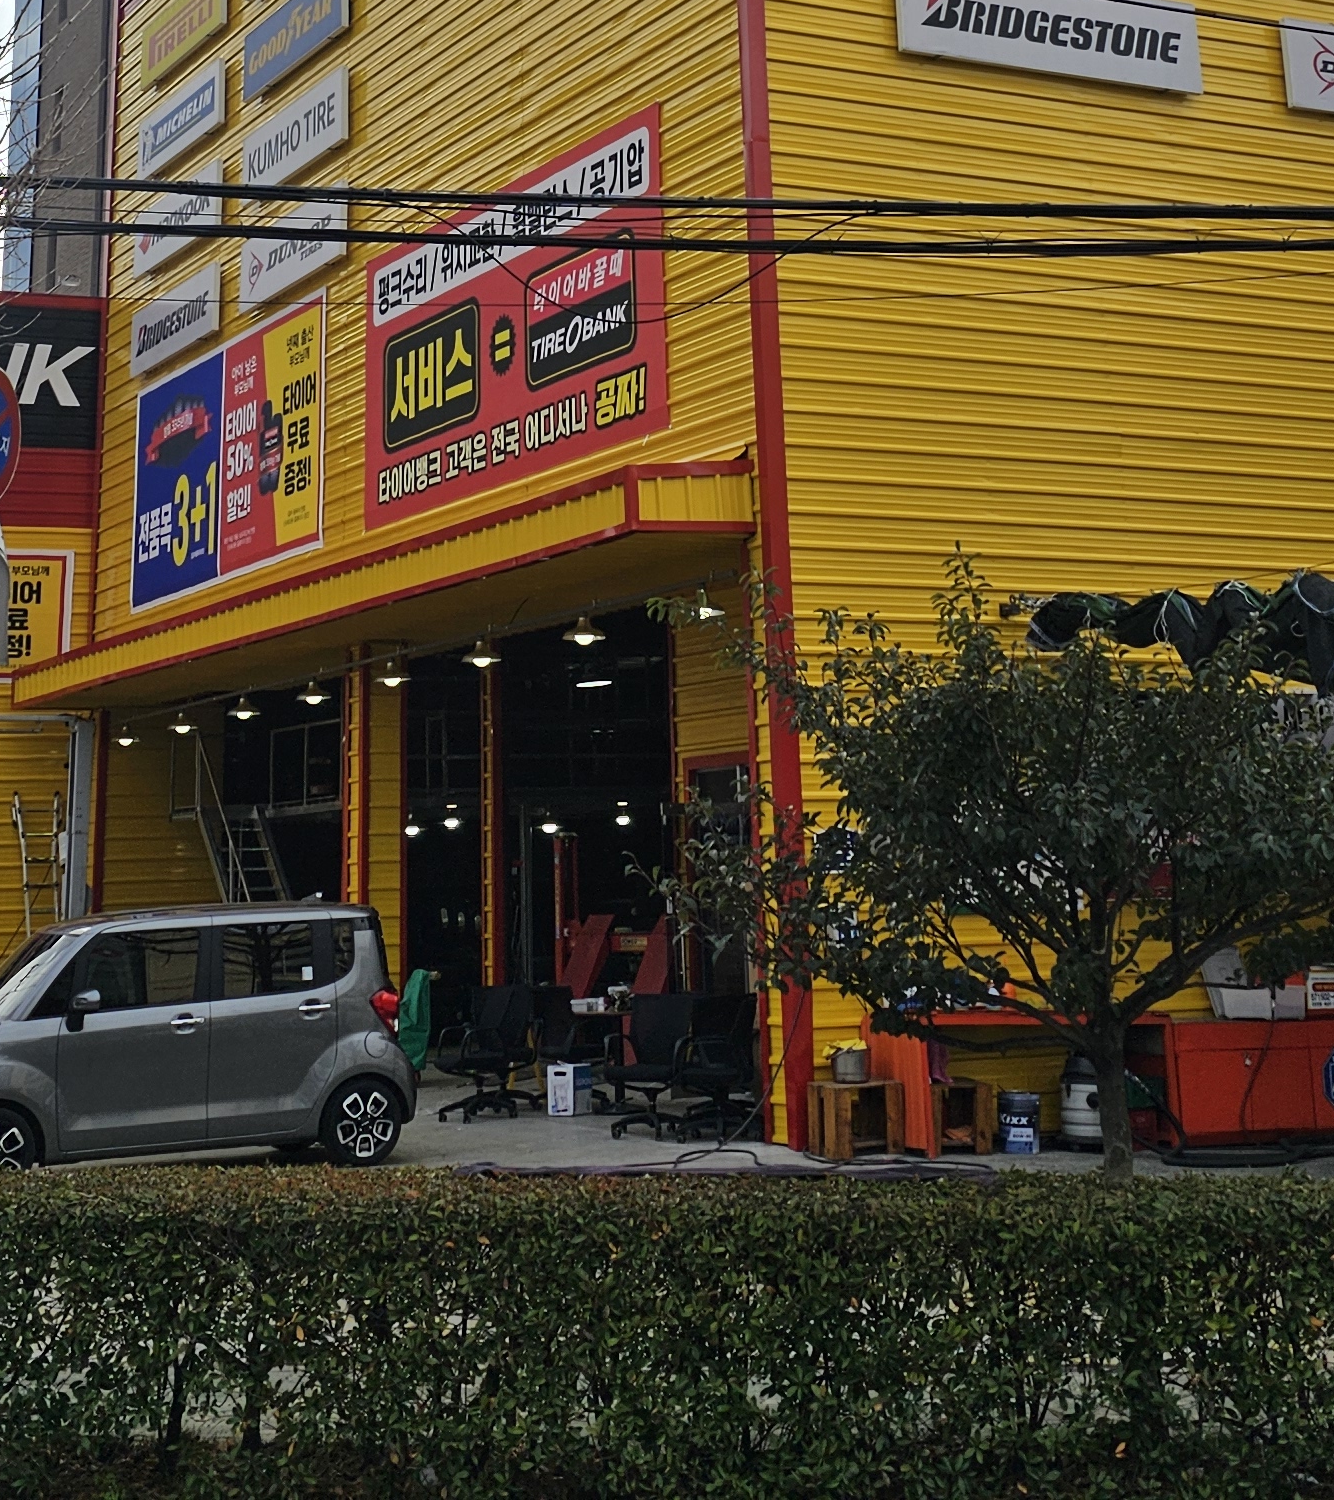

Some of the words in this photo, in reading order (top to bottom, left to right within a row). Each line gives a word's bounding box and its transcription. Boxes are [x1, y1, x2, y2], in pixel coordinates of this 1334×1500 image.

[156, 85, 213, 145] MICHELIN
[248, 120, 301, 182] KUMHO
[304, 92, 336, 143] TIRE
[378, 254, 427, 315] 펑크수리
[135, 290, 209, 358] BRIDGESTONE
[283, 370, 317, 415] 타이어
[390, 327, 473, 423] 서비스
[226, 400, 257, 442] 타이어
[287, 417, 310, 454] 무료
[378, 450, 442, 504] 타이어뱅크
[446, 434, 487, 480] 고객은
[491, 419, 521, 465] 전국
[525, 395, 588, 450] 어디서나
[595, 363, 647, 426] 공짜!
[227, 440, 254, 481] 50%
[284, 455, 312, 496] 증정!
[137, 502, 172, 563] 전품목
[172, 460, 217, 567] 3+1
[227, 483, 251, 522] 할인!
[12, 565, 50, 576] 부모님께
